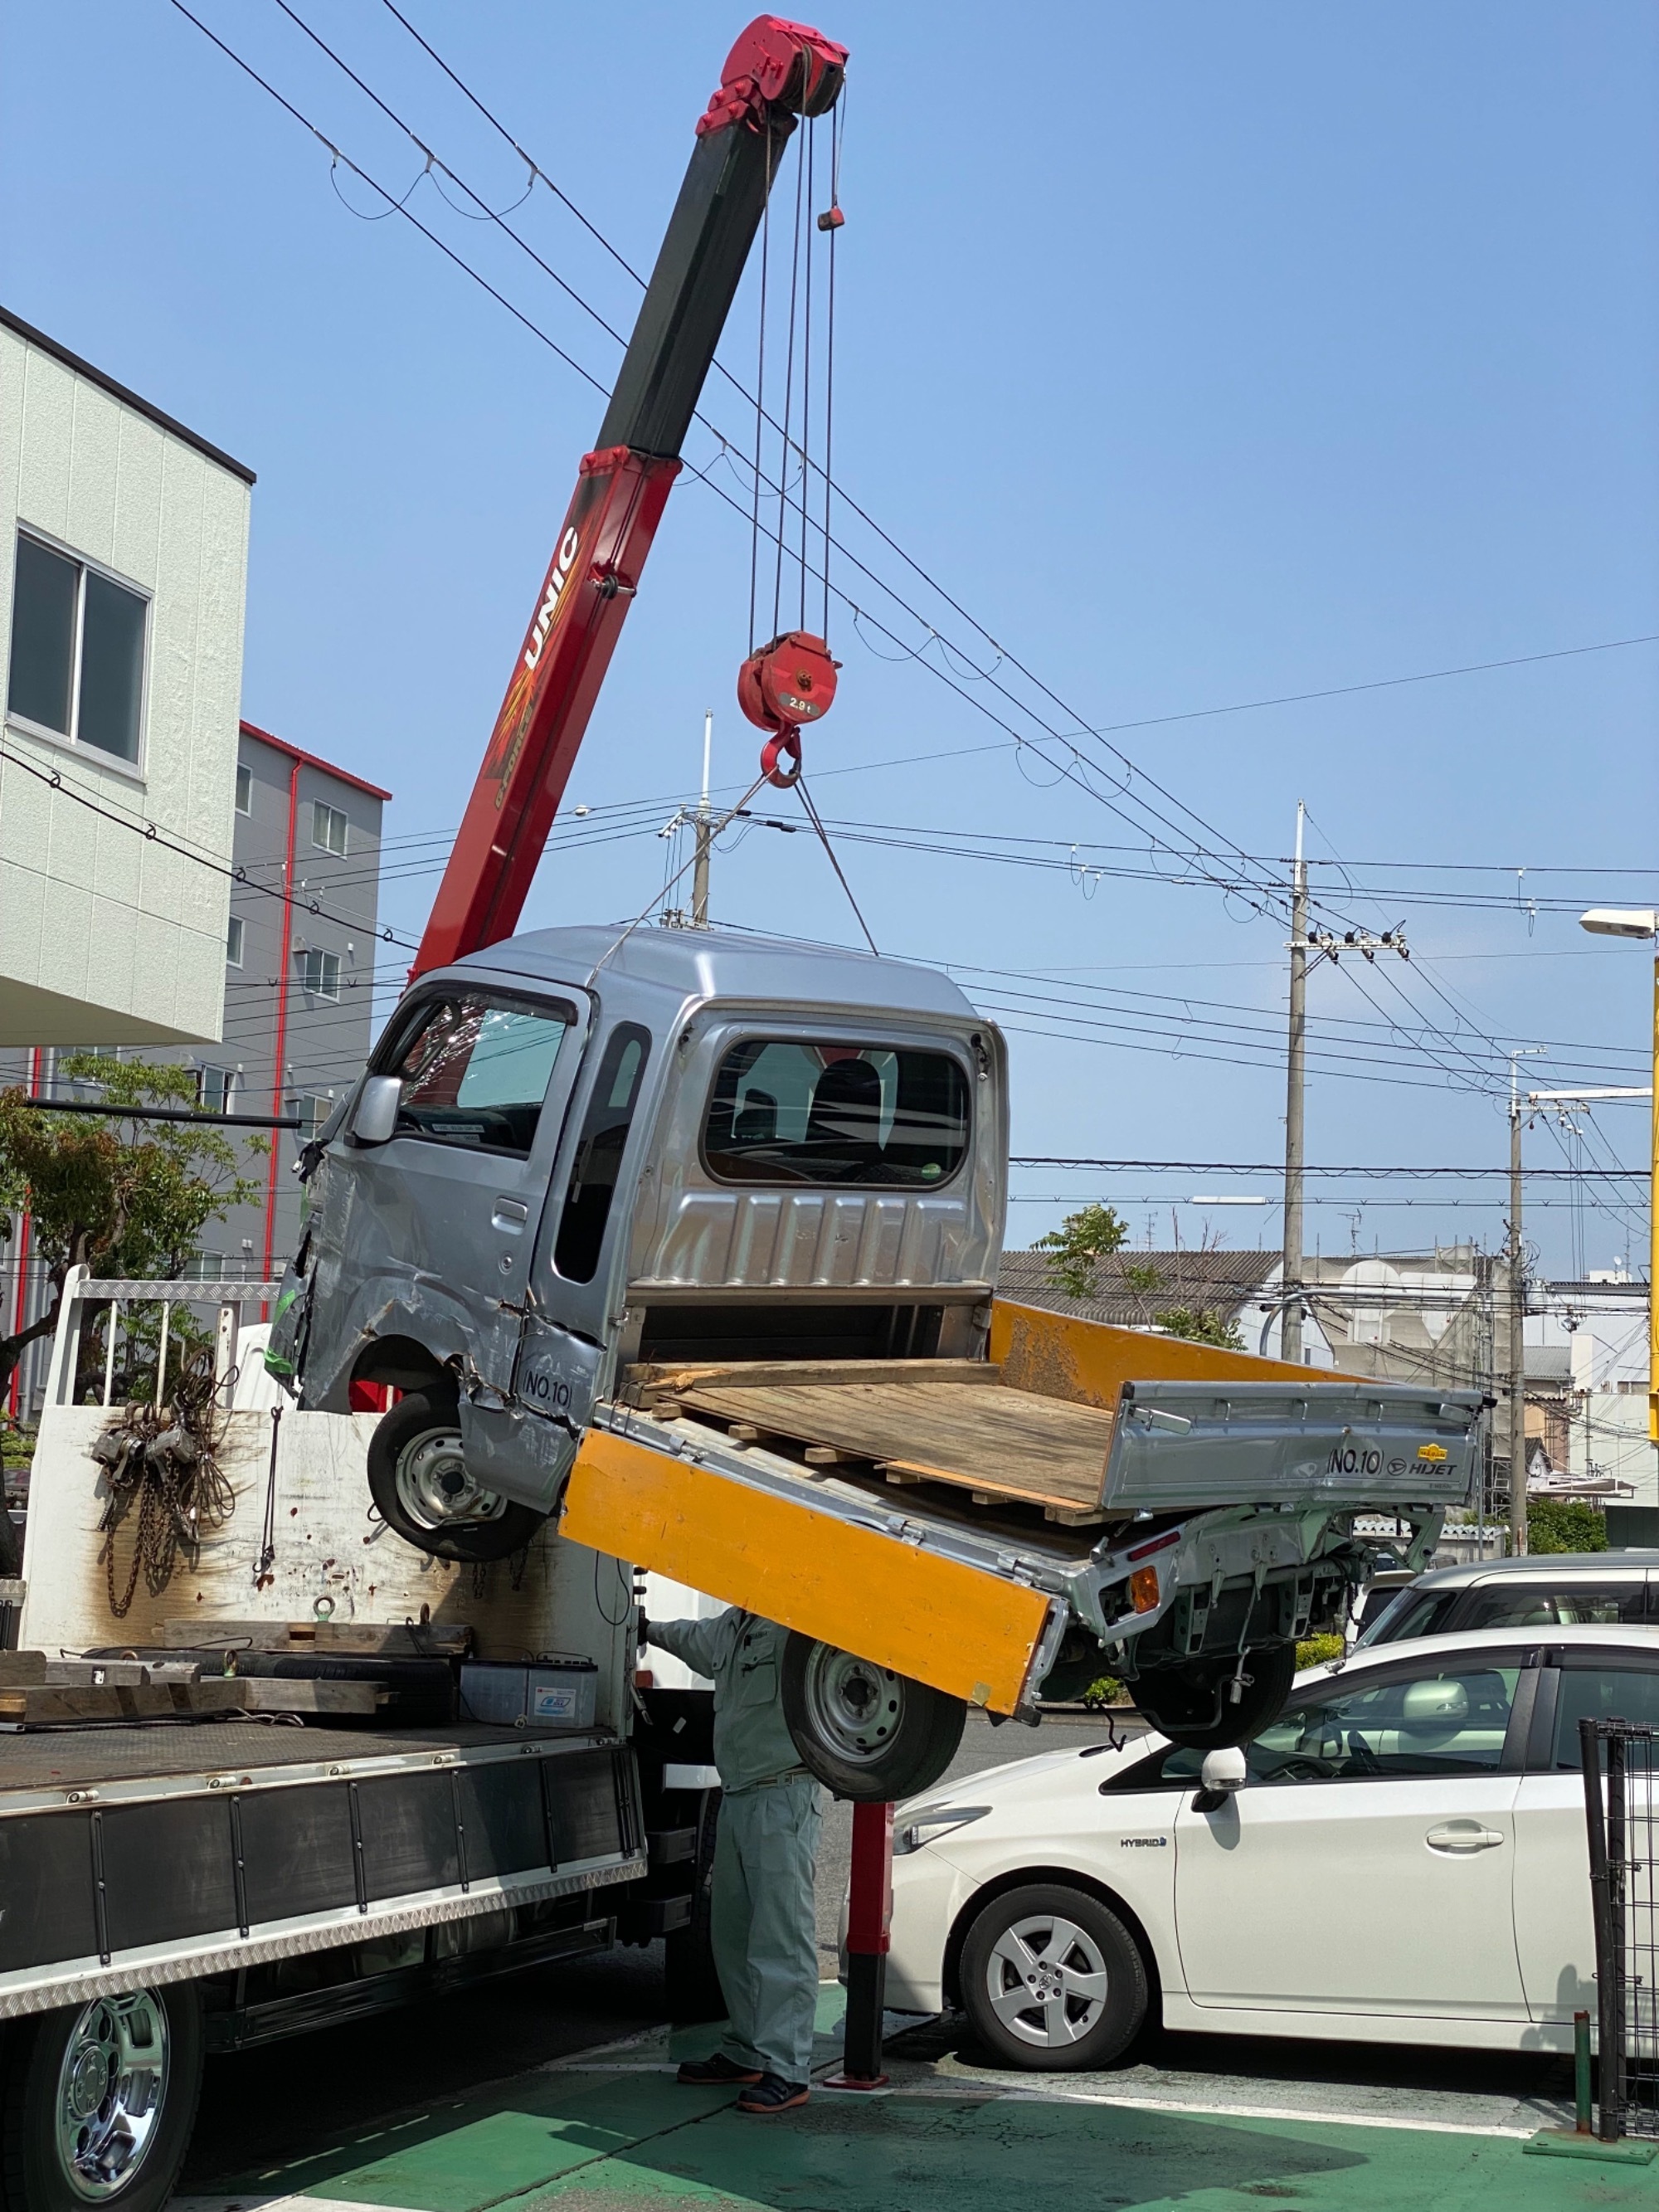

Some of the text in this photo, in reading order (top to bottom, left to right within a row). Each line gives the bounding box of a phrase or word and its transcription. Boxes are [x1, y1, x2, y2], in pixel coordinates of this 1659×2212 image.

[524, 526, 578, 670] UNIC
[1408, 1464, 1457, 1475] HIJET
[1121, 1838, 1160, 1848] HYBRID
